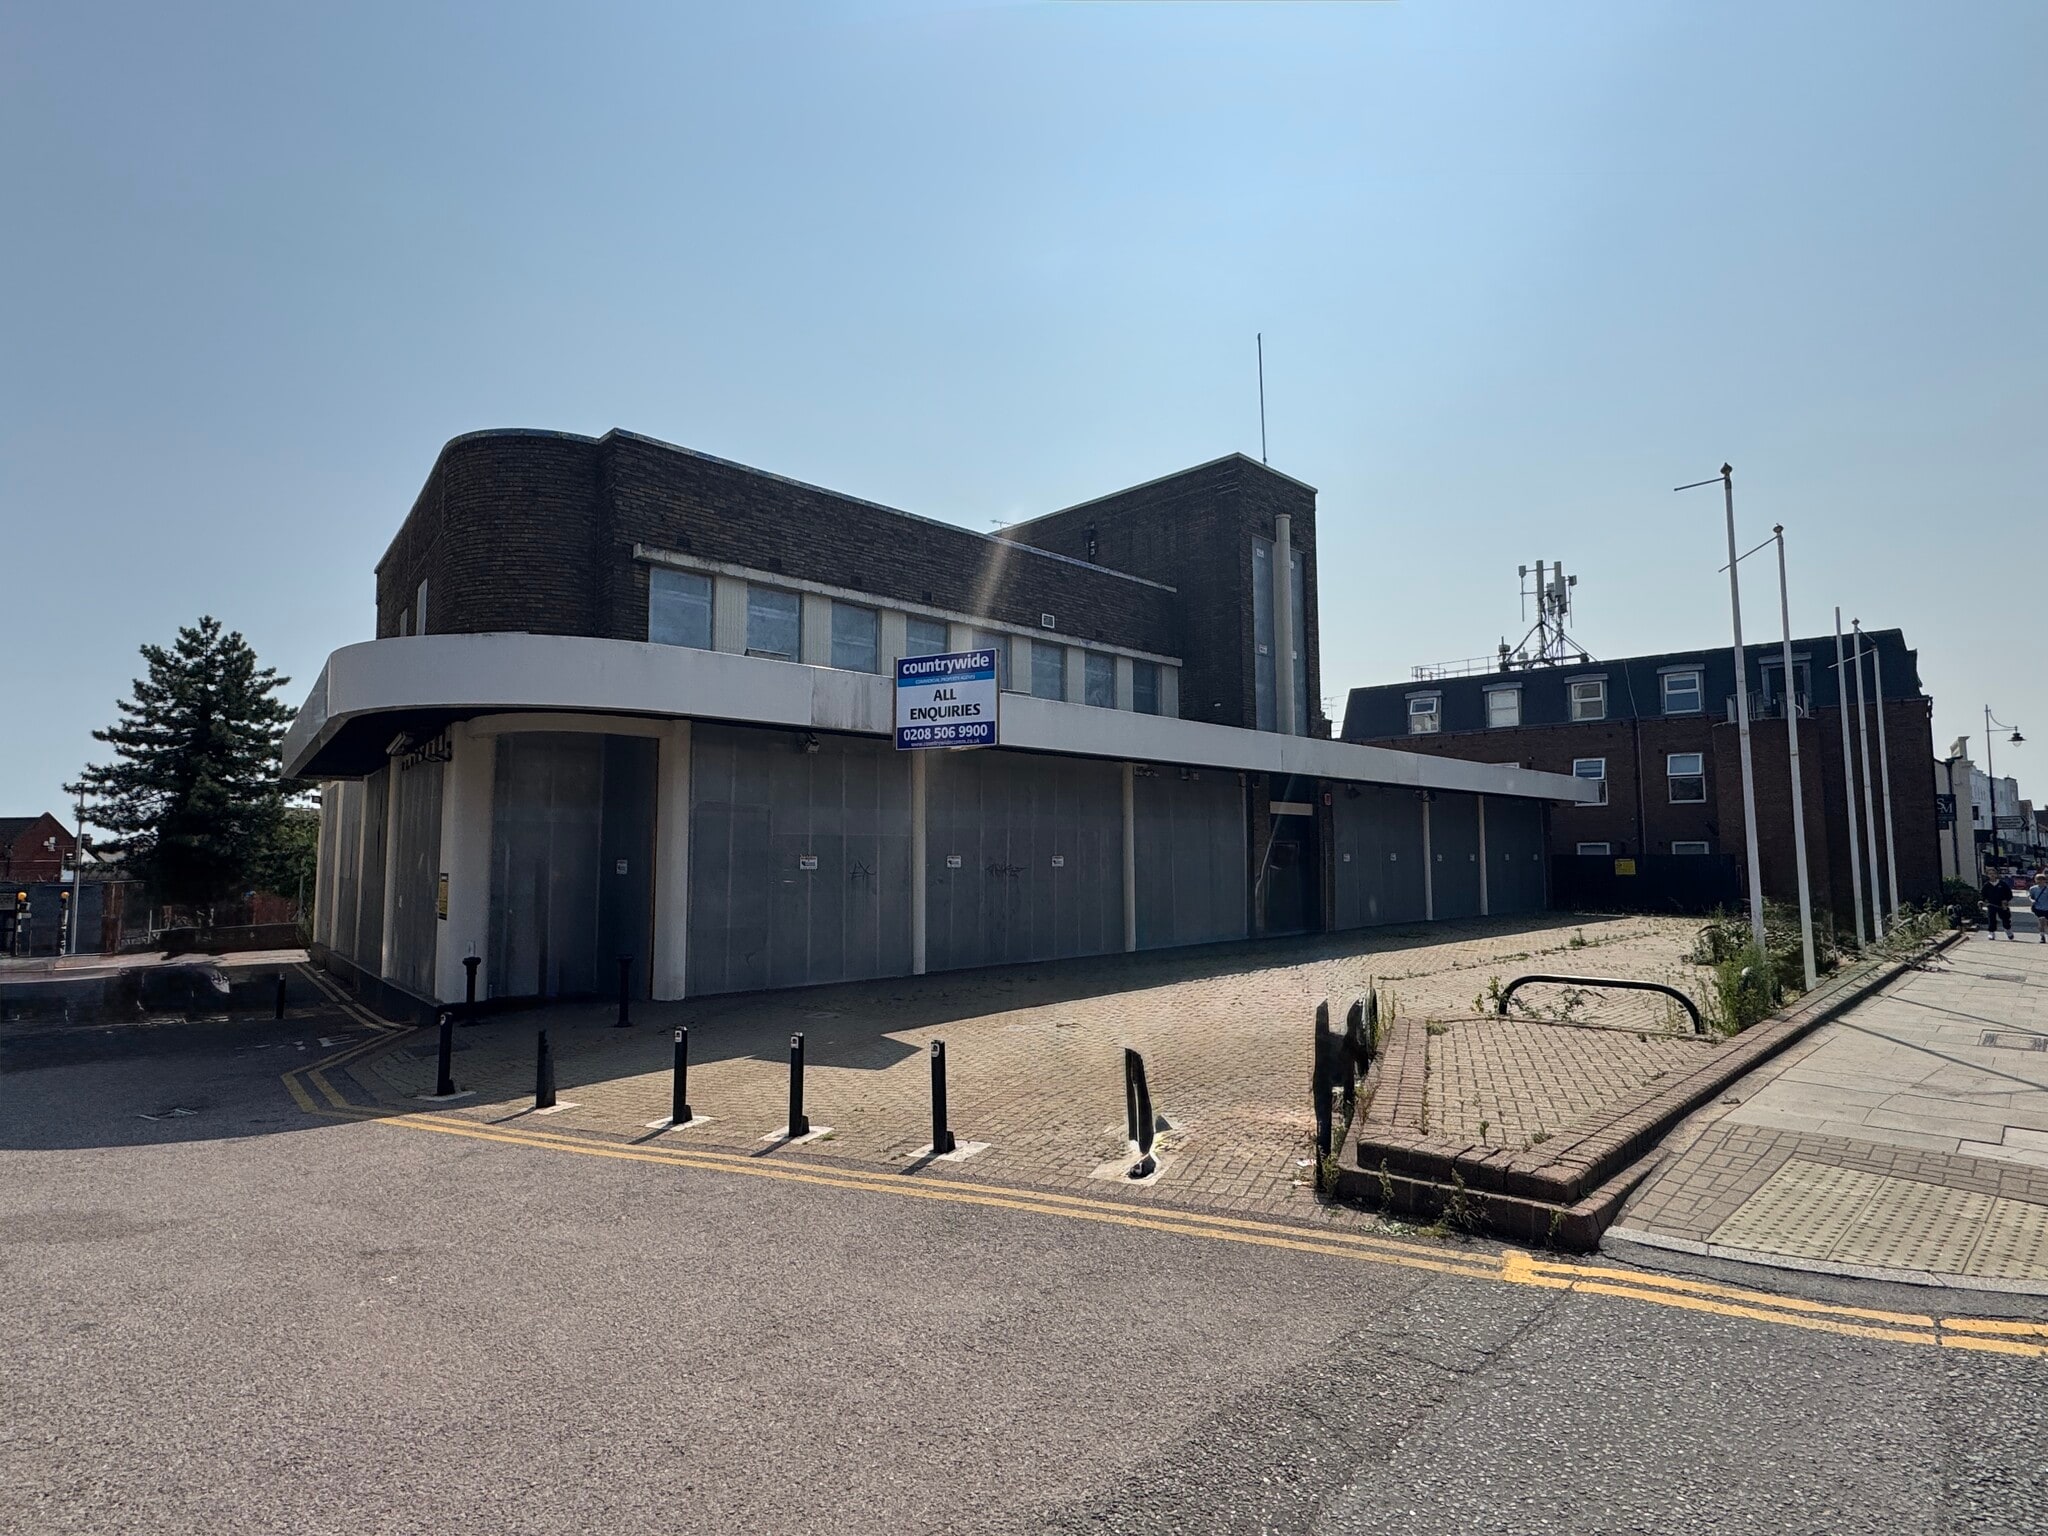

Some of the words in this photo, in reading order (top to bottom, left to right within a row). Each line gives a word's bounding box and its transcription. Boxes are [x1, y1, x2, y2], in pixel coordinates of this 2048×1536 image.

[902, 653, 990, 675] countrywide
[933, 688, 957, 702] ALL
[910, 703, 981, 722] ENQUIRIES
[903, 728, 931, 741] 0208
[934, 726, 956, 739] 506
[958, 724, 988, 738] 9900
